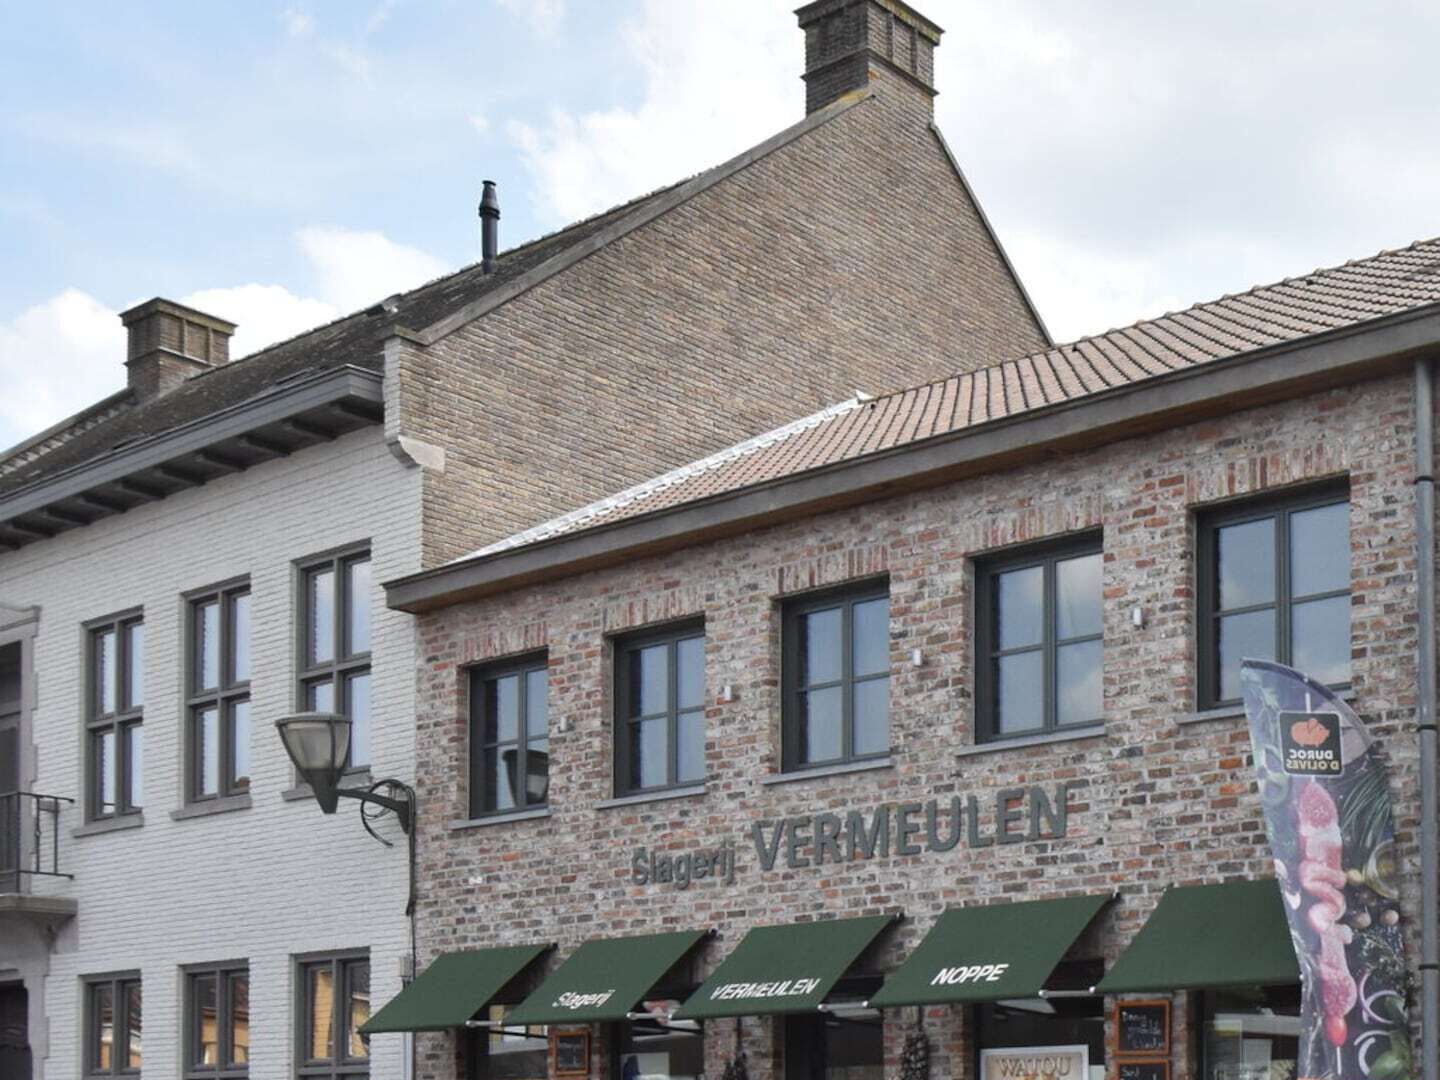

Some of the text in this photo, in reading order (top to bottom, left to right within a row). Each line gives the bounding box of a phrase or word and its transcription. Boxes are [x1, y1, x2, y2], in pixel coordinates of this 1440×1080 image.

[631, 784, 1072, 890] Slagerij VERMEULEN
[930, 963, 1009, 986] NOPPE
[552, 989, 616, 1010] Slagerij
[710, 978, 820, 1000] VERMEULEN
[998, 1056, 1072, 1077] WATOU
